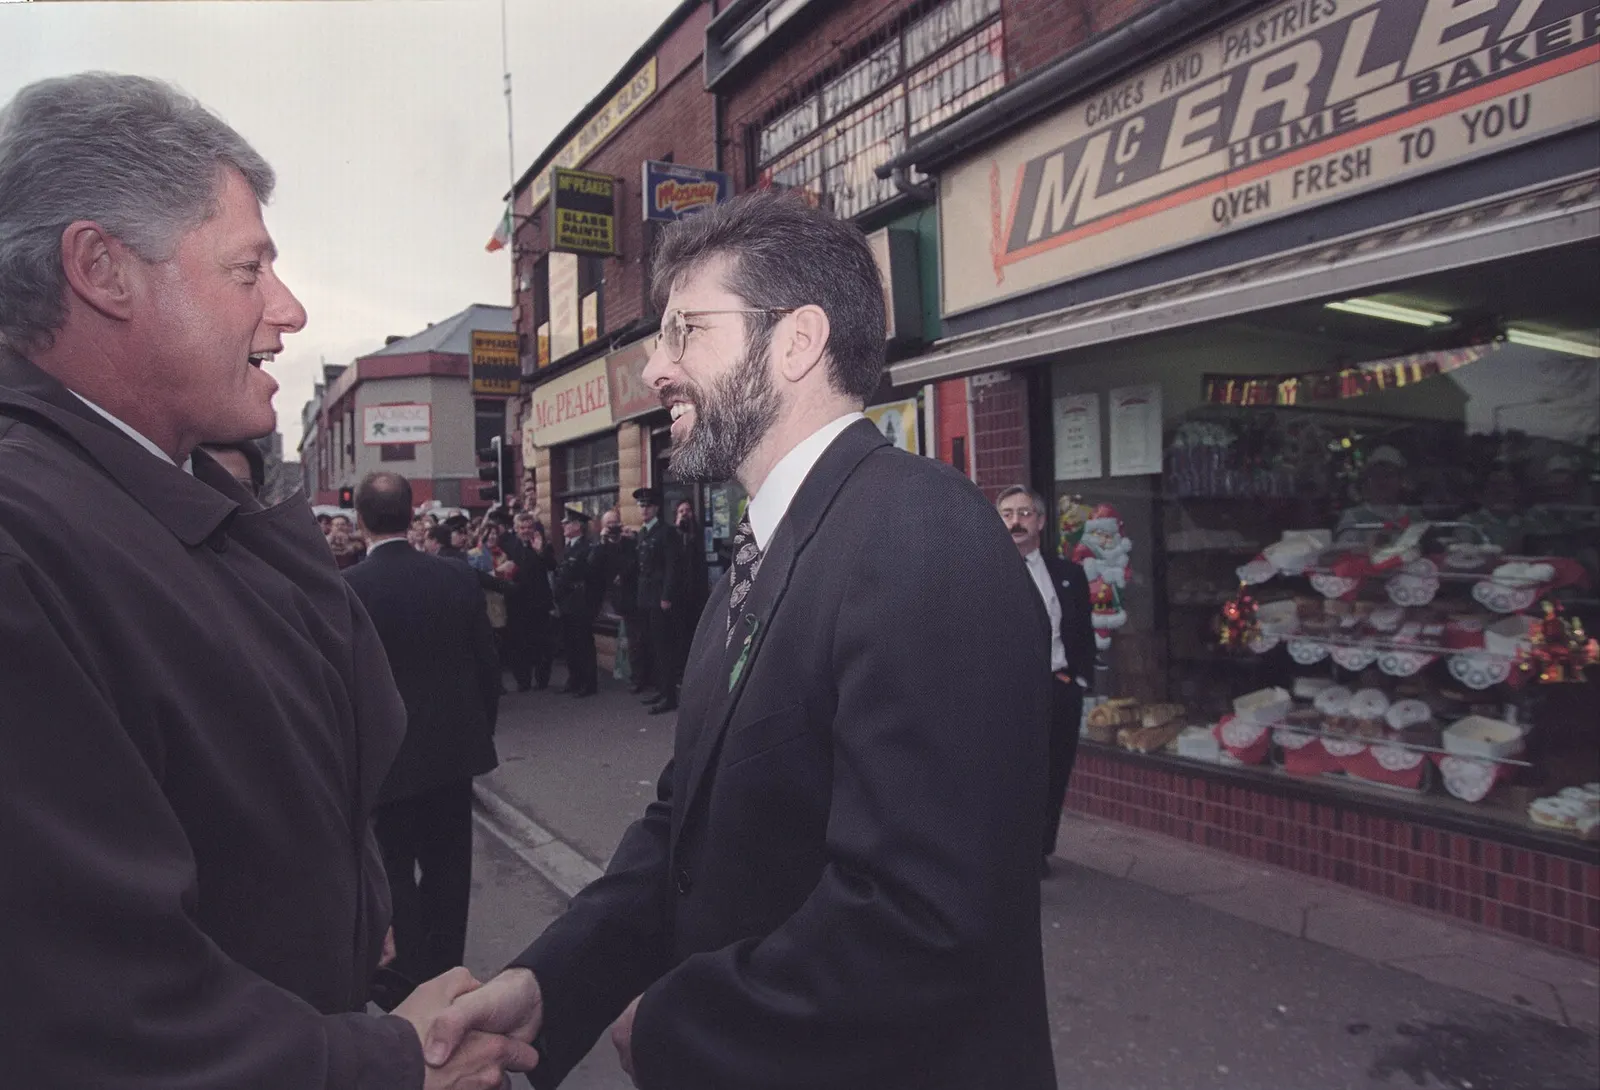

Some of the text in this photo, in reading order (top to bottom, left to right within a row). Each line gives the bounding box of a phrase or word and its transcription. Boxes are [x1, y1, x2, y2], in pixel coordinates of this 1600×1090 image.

[1085, 0, 1338, 127] CAKES AND PASTRIES
[1212, 92, 1531, 223] OVEN FRESH TO YOU
[1229, 101, 1358, 170] HOME
[562, 223, 608, 239] PAINTS
[563, 211, 608, 227] GLASS
